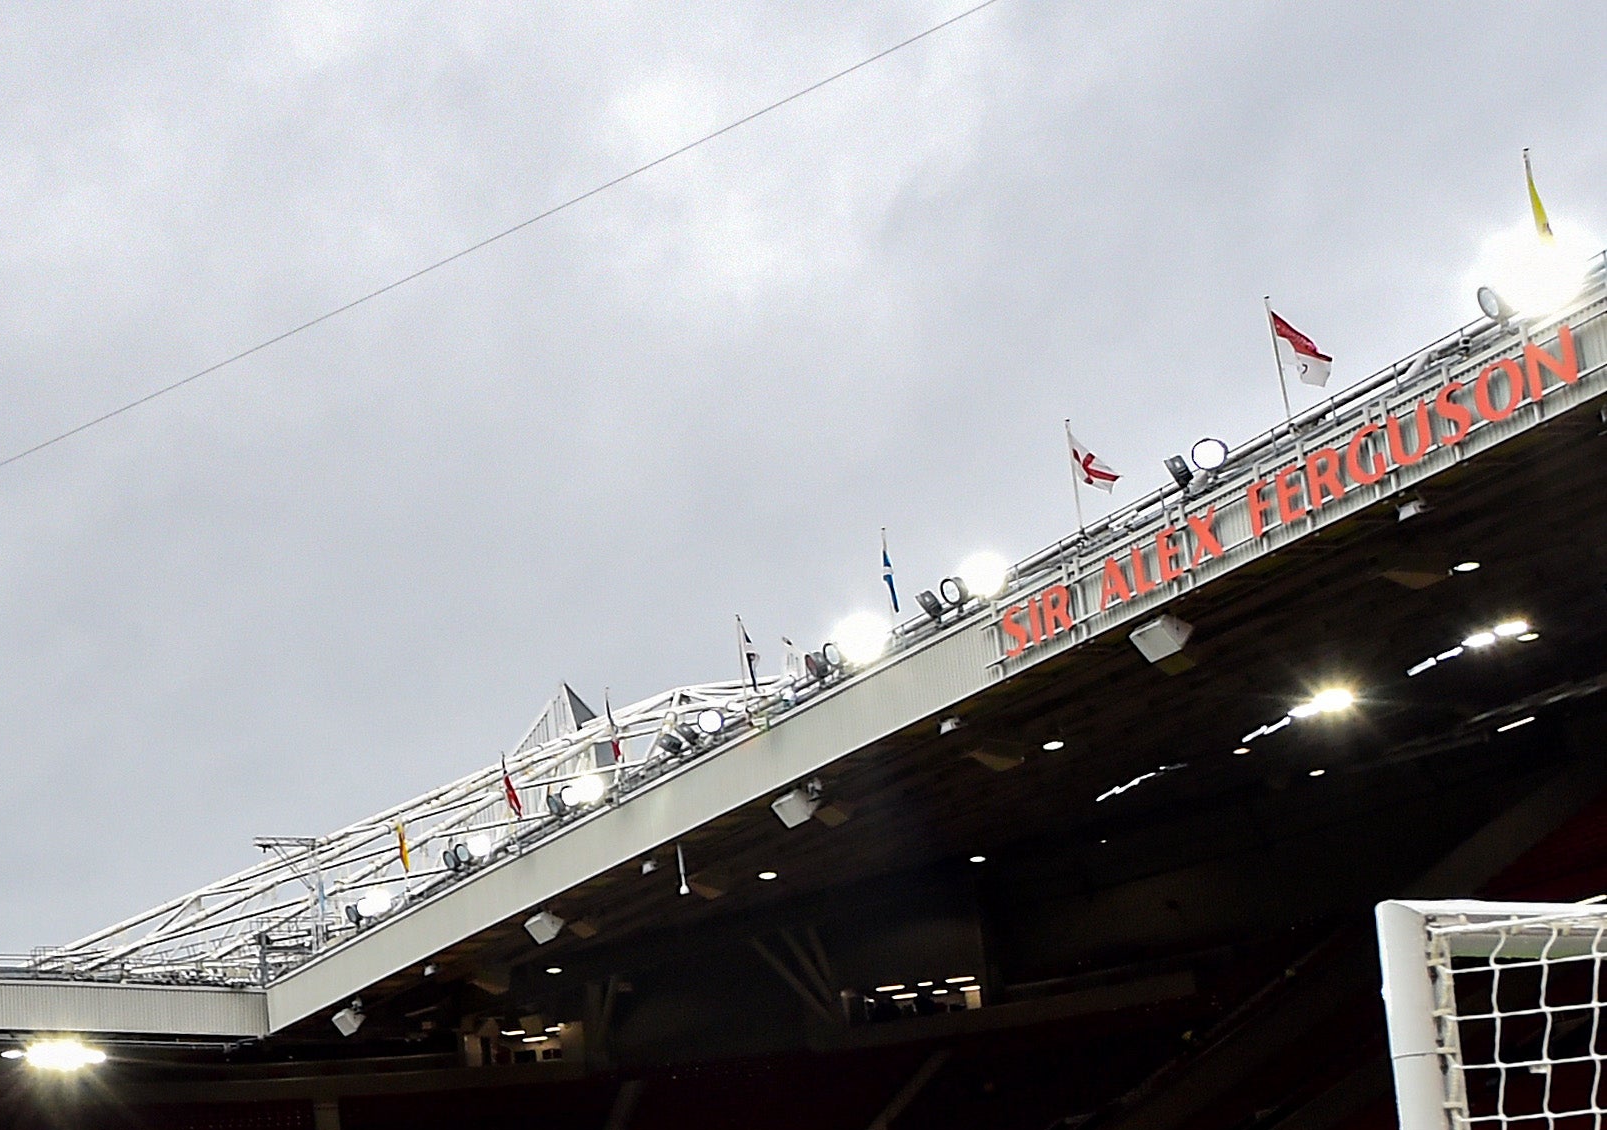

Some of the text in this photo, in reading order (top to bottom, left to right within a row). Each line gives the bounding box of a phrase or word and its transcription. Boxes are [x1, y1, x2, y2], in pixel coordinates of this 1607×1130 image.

[1001, 325, 1579, 658] SIR ALEX FERGUSON
